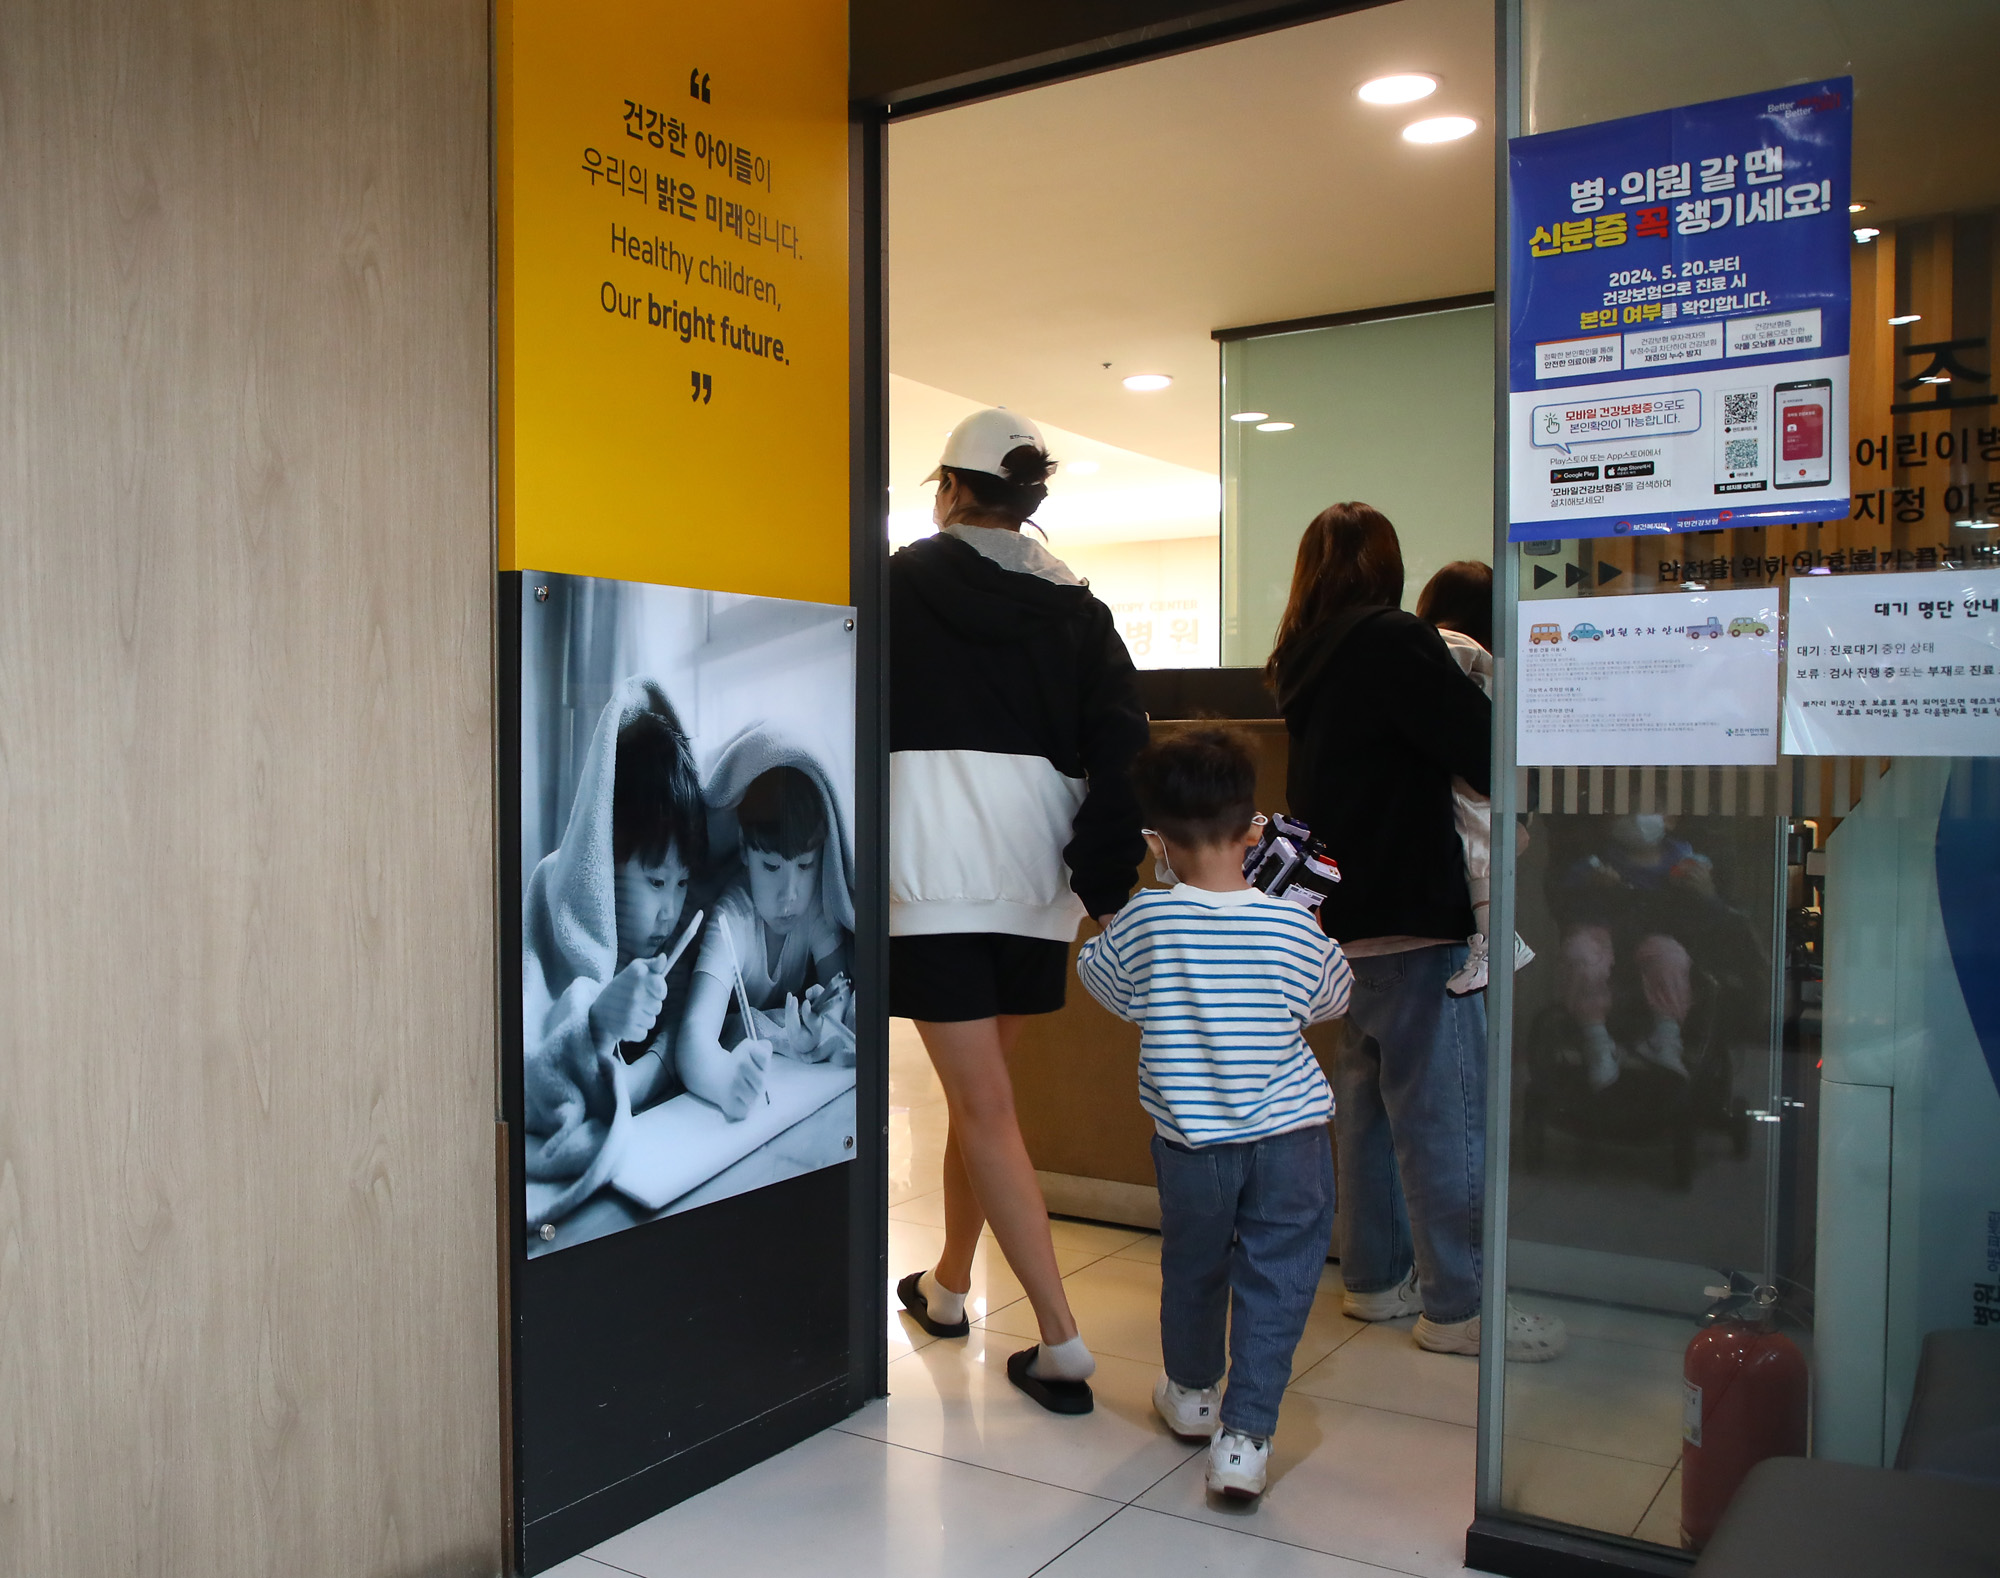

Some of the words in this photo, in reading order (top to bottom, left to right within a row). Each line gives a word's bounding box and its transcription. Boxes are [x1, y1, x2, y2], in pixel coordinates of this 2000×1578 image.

[623, 99, 688, 158] 건강한
[695, 131, 771, 193] 아이들이
[1570, 162, 1692, 214] 병·의원
[1700, 154, 1738, 193] 갈
[1745, 146, 1783, 185] 땐
[581, 147, 648, 204] 우리의
[656, 173, 697, 222] 밝은
[706, 194, 803, 260] 미래입니다.
[1529, 212, 1629, 258] 신분증
[1635, 206, 1670, 239] 꼭
[1675, 180, 1831, 235] 챙기세요!
[611, 223, 693, 284] Healthy
[699, 255, 781, 312] children,
[1609, 269, 1657, 287] 2024.
[1662, 265, 1677, 279] 5.
[1681, 256, 1740, 278] 20.부터
[1603, 280, 1692, 306] 건강보험으로
[1696, 275, 1727, 294] 진료
[1730, 273, 1747, 288] 시
[1580, 309, 1618, 330] 본인
[1623, 303, 1678, 324] 여부를
[1682, 291, 1771, 315] 확인합니다.
[601, 281, 641, 320] Our
[648, 293, 715, 344] bright
[721, 316, 790, 366] future.
[1659, 342, 1687, 352] 차단하여
[1689, 338, 1717, 349] 건강보험
[1752, 339, 1776, 349] 오남용
[1778, 336, 1795, 346] 사전
[1796, 334, 1813, 344] 예방
[1544, 352, 1564, 361] 정확한
[1565, 347, 1599, 358] 본인확인을
[1600, 346, 1614, 354] 통해
[1644, 352, 1668, 362] 재정의
[1669, 351, 1685, 360] 누수
[1686, 349, 1702, 358] 방지
[1544, 360, 1566, 369] 안전한
[1567, 356, 1597, 366] 의료이용
[1598, 354, 1613, 362] 가능
[1565, 409, 1597, 422] 모바일
[1600, 399, 1685, 418] 건강보험증으로도
[1570, 419, 1621, 434] 본인확인이
[1625, 413, 1681, 428] 가능합니다.
[1550, 453, 1588, 466] Play스토어
[1590, 453, 1605, 462] 또는
[1607, 448, 1662, 461] App스토어에서
[1564, 471, 1583, 479] Google
[1584, 470, 1596, 478] Play
[1636, 479, 1672, 491] 검색하여
[1550, 495, 1605, 508] 설치해보세요!
[1854, 487, 1925, 525] 지정
[1677, 518, 1719, 528] 국민건강보험
[1149, 599, 1198, 612] CENTER
[1874, 602, 1908, 617] 대기
[1918, 600, 1954, 619] 명단
[1963, 599, 2000, 618] 안내
[1606, 626, 1628, 638] 병원
[1635, 626, 1656, 637] 주차
[1662, 625, 1685, 635] 안내
[1796, 645, 1820, 656] 대기
[1829, 643, 1878, 656] 진료대기
[1881, 642, 1906, 655] 중인
[1910, 641, 1935, 654] 상태
[1796, 668, 1820, 679] 보류
[1829, 667, 1853, 680] 검사
[1856, 667, 1880, 679] 진행
[1883, 667, 1895, 679] 중
[1899, 667, 1923, 677] 또는
[1927, 665, 1966, 677] 부재로
[1969, 665, 1995, 676] 진료
[1831, 700, 1855, 709] 비우신
[1860, 699, 1867, 707] 후
[1872, 699, 1896, 707] 보류로
[1901, 698, 1918, 706] 표시
[1837, 708, 1861, 716] 보류로
[1903, 708, 1920, 717] 경우
[1924, 707, 1967, 718] 다음환자로
